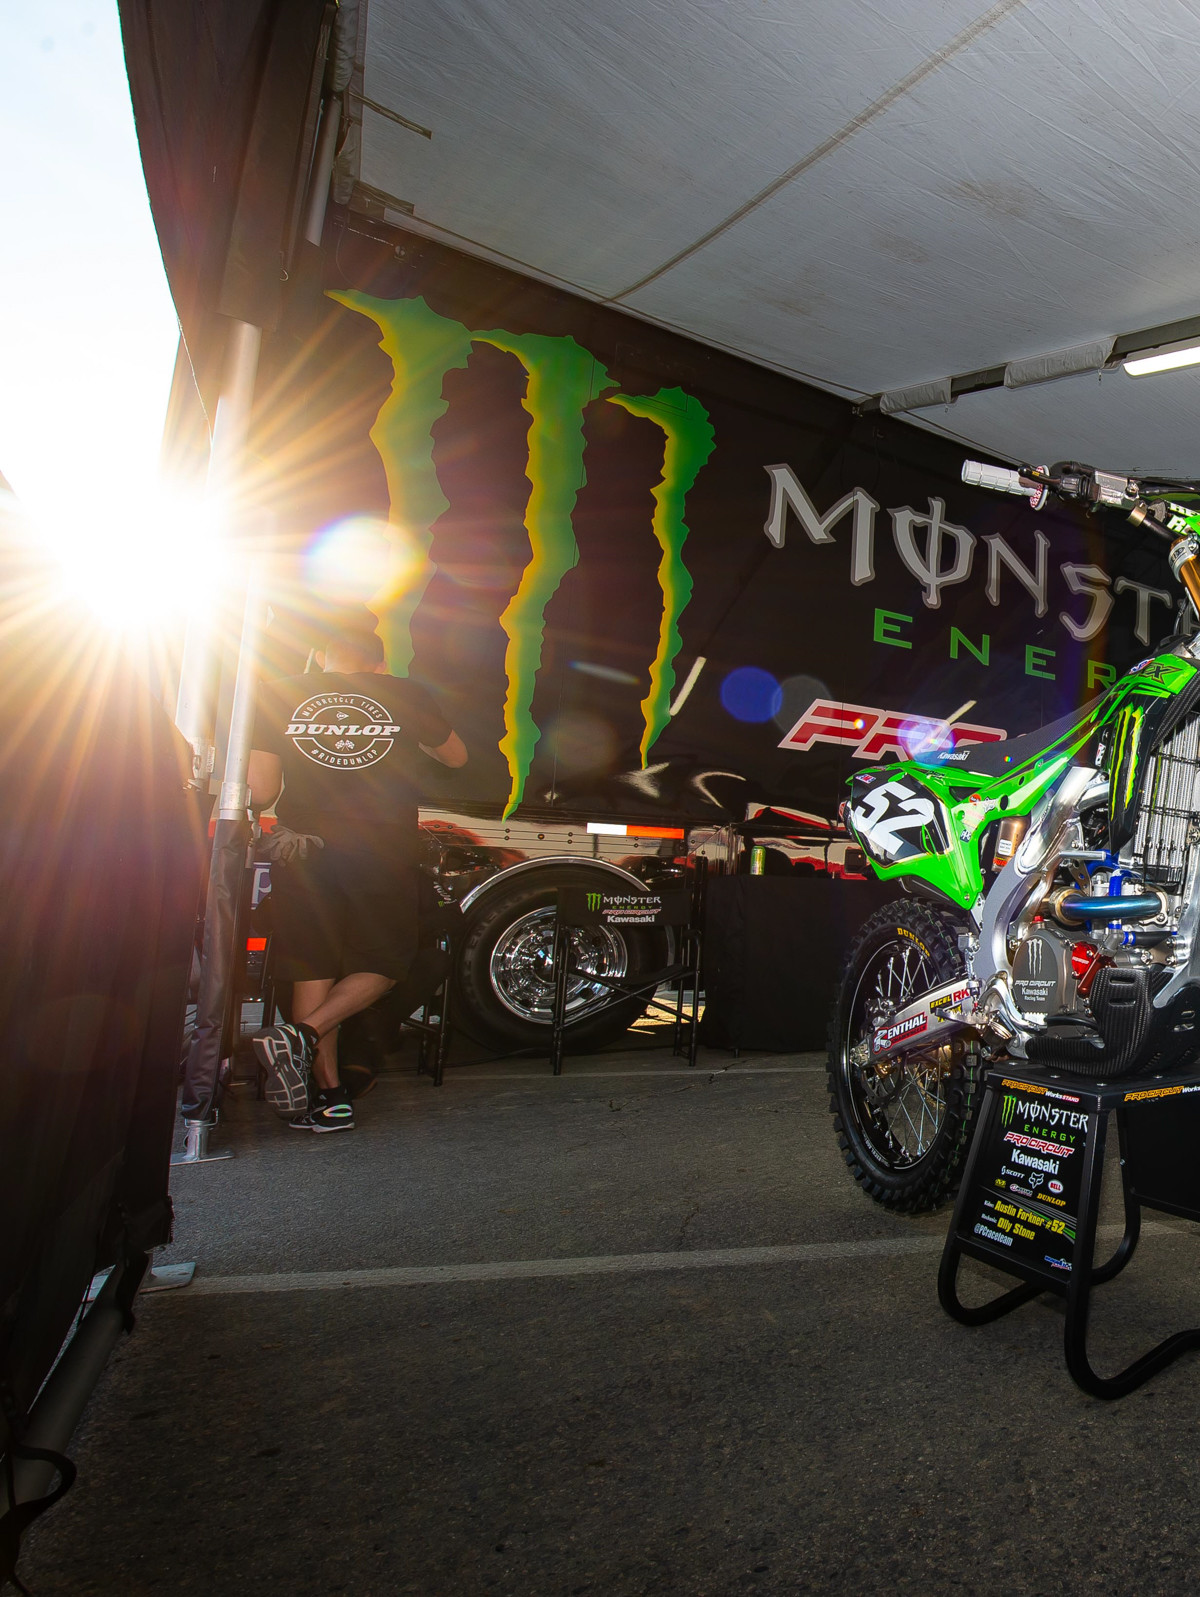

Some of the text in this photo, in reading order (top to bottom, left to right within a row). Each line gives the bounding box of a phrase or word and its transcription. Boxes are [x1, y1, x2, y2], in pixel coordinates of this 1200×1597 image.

[302, 697, 383, 718] MOTORCYCLE TIRES
[285, 724, 400, 735] DUNLOP
[311, 749, 378, 765] #RIDEDUNLOP
[854, 781, 935, 856] 52
[607, 915, 655, 923] Kawasaki
[897, 927, 930, 957] DUNLOP
[953, 987, 970, 1002] RK
[1022, 987, 1048, 996] Kawasaki
[930, 994, 952, 1009] EXCEL
[1045, 1091, 1062, 1099] Works
[1182, 1085, 1200, 1093] Works
[1017, 1100, 1089, 1133] MONSTER
[1024, 1124, 1075, 1143] ENERGY
[1004, 1131, 1075, 1157] PRO CIRCUIT
[1011, 1149, 1059, 1175] Kawasaki
[1006, 1168, 1025, 1178] SCOTT
[1037, 1193, 1066, 1207] DUNLOP
[994, 1200, 1016, 1217] Austin
[1017, 1208, 1045, 1226] Forkner
[1045, 1219, 1066, 1234] #52
[974, 1223, 1013, 1246] @PCraceteam
[997, 1217, 1013, 1232] Olly
[1013, 1223, 1035, 1240] Stone
